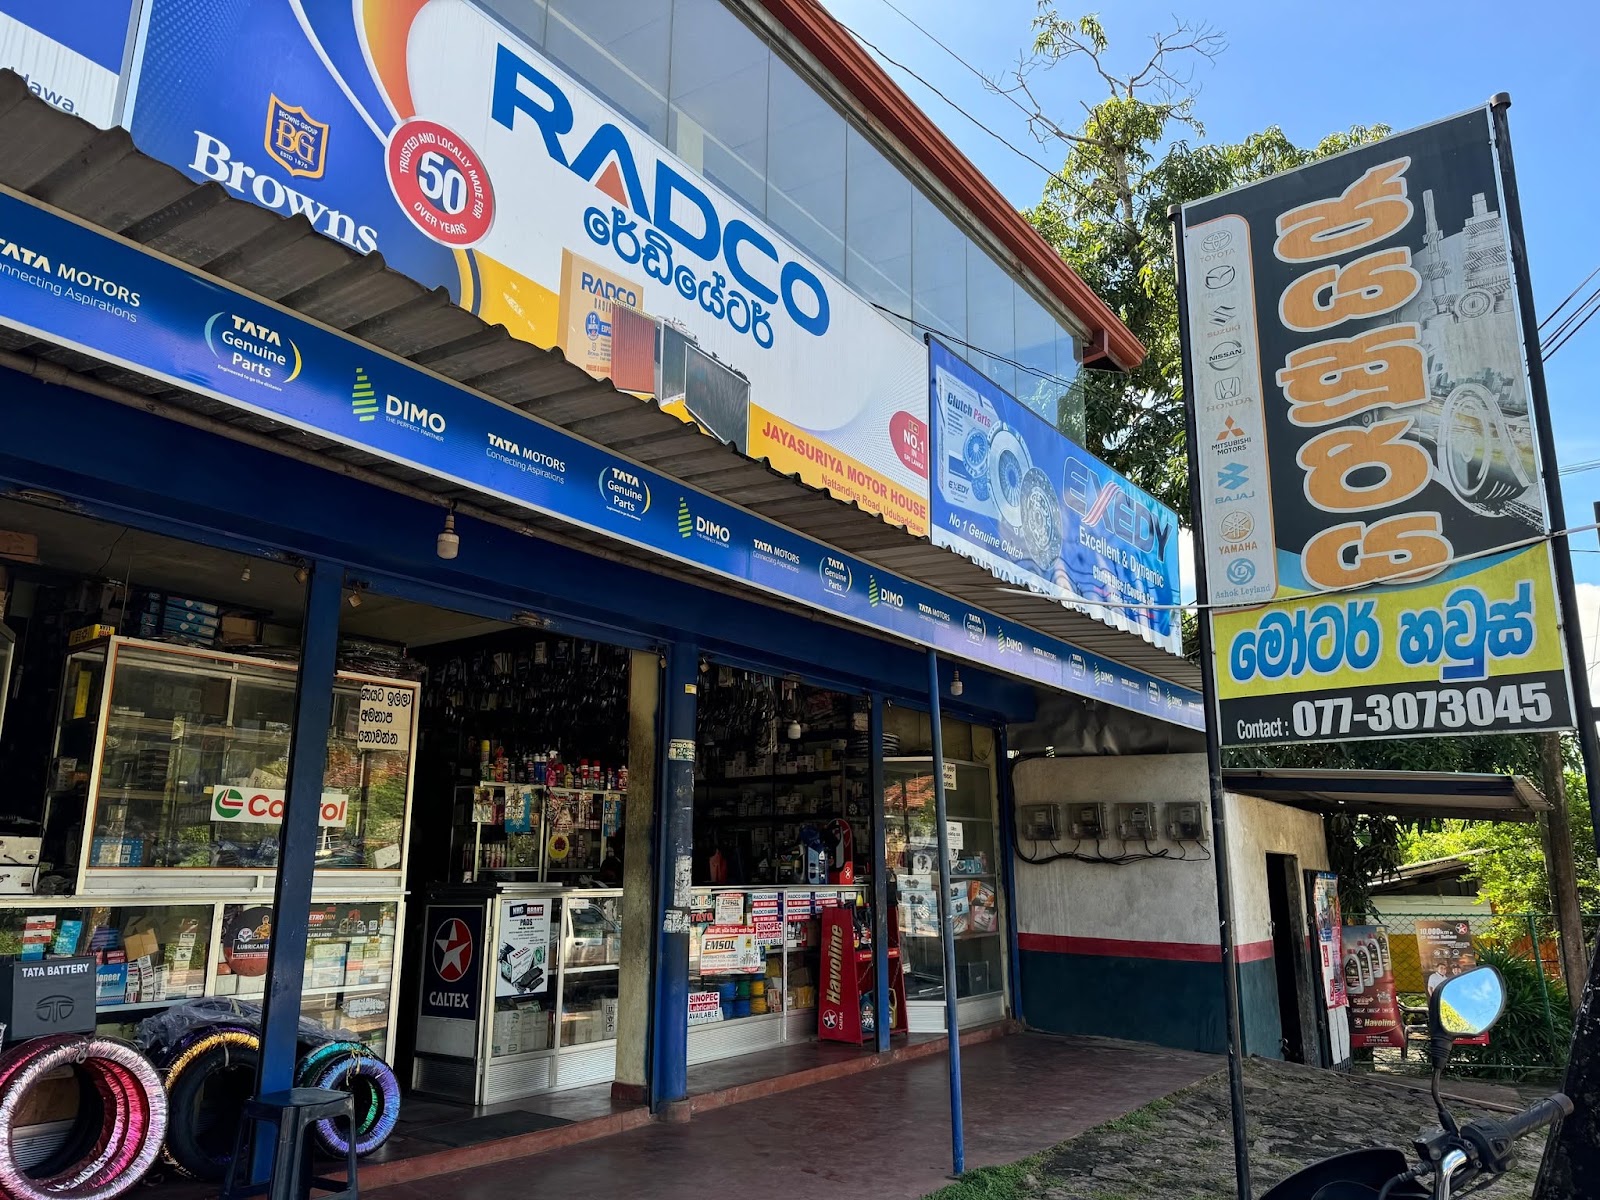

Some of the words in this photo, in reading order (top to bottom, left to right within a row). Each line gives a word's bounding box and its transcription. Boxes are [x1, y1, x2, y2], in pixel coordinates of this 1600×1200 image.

[278, 110, 300, 126] BROWNS
[300, 122, 318, 135] GROUP
[276, 119, 316, 166] BG
[418, 133, 436, 144] AND
[400, 136, 419, 174] TRUSTED
[437, 135, 472, 168] LOCALLY
[419, 151, 467, 215] 50
[468, 169, 484, 200] MADE
[491, 42, 831, 337] RADCO
[188, 130, 378, 256] Browns
[414, 202, 438, 227] OVER
[439, 220, 467, 235] YEARS
[472, 203, 484, 219] FOR
[1200, 248, 1236, 263] TOYOTA
[57, 263, 141, 308] MOTORS
[584, 206, 775, 349] රේඩියේටර්
[581, 271, 636, 307] RADCO
[65, 287, 137, 323] Aspirations
[232, 314, 282, 347] TATA
[1207, 324, 1241, 338] SUZUKI
[222, 331, 287, 366] Genuine
[1209, 348, 1243, 362] NISSAN
[232, 352, 272, 378] Parts
[1273, 156, 1454, 591] ජයසූරිය
[386, 394, 446, 433] DIMO
[947, 392, 973, 417] Clutch
[973, 408, 992, 428] Parts
[1206, 397, 1253, 413] HONDA
[386, 415, 396, 424] THE
[397, 419, 420, 433] PERFECT
[420, 428, 445, 443] PARTNER
[903, 429, 925, 454] NO.1
[1211, 437, 1251, 450] MITSUBISHI
[487, 432, 520, 456] TATA
[522, 447, 566, 473] MOTORS
[1217, 445, 1247, 456] MOTORS
[486, 447, 526, 472] Connecting
[526, 464, 565, 485] Aspirations
[903, 453, 912, 462] SRI
[911, 458, 924, 470] LANKA
[612, 467, 640, 488] TATA
[762, 421, 845, 477] JAYASURIYA
[847, 465, 888, 500] MOTOR
[890, 489, 926, 521] HOUSE
[607, 480, 643, 502] Genuine
[948, 480, 969, 495] EXEDY
[613, 495, 636, 512] Parts
[821, 473, 861, 502] Nattandiya
[883, 505, 925, 534] Udubaddawa
[1215, 491, 1254, 505] BAJAJ
[1063, 456, 1174, 563] EXEDY
[696, 515, 730, 543] DIMO
[948, 512, 961, 529] No
[962, 519, 968, 532] 1
[968, 521, 1000, 549] Genuine
[1000, 538, 1024, 560] Clutch
[753, 538, 773, 554] TATA
[773, 546, 800, 565] MOTORS
[1219, 540, 1258, 555] YAMAHA
[752, 550, 777, 566] Connecting
[827, 556, 845, 571] TATA
[1079, 525, 1121, 564] Excellent
[1121, 550, 1129, 570] &
[1130, 554, 1165, 588] Dynamic
[824, 567, 847, 583] Genuine
[828, 579, 842, 592] Parts
[1215, 587, 1239, 599] Ashok
[1240, 584, 1271, 596] Leyland
[880, 588, 904, 608] DIMO
[918, 602, 932, 615] TATA
[932, 607, 951, 622] MOTORS
[968, 613, 982, 624] TATA
[966, 622, 983, 633] Genuine
[1231, 600, 1380, 682] මෝටර්
[1399, 583, 1533, 681] හවුස්
[969, 631, 980, 642] Parts
[1006, 636, 1023, 653] DIMO
[1100, 671, 1114, 684] DIMO
[1237, 719, 1283, 741] Contact
[1292, 681, 1552, 738] 077-3073045
[358, 728, 398, 745] නොවන්න
[308, 913, 336, 922] ETROMIN
[512, 906, 524, 915] NHC
[526, 906, 543, 915] BRAKE
[519, 918, 533, 926] PADS
[757, 922, 782, 931] SINOPEC
[757, 931, 782, 939] Lubricants
[757, 938, 782, 946] AVAILABLE
[236, 942, 270, 951] LUBRICANTS
[512, 946, 529, 958] NHC
[704, 940, 736, 950] EMSOL
[22, 966, 45, 978] TATA
[47, 963, 90, 976] BATTERY
[826, 924, 843, 1006] Havoline
[429, 991, 470, 1009] CALTEX
[689, 993, 718, 1003] SINOPEC
[689, 1002, 718, 1011] Lubricants
[689, 1010, 718, 1020] AVAILABLE
[1364, 1018, 1396, 1028] Havoline
